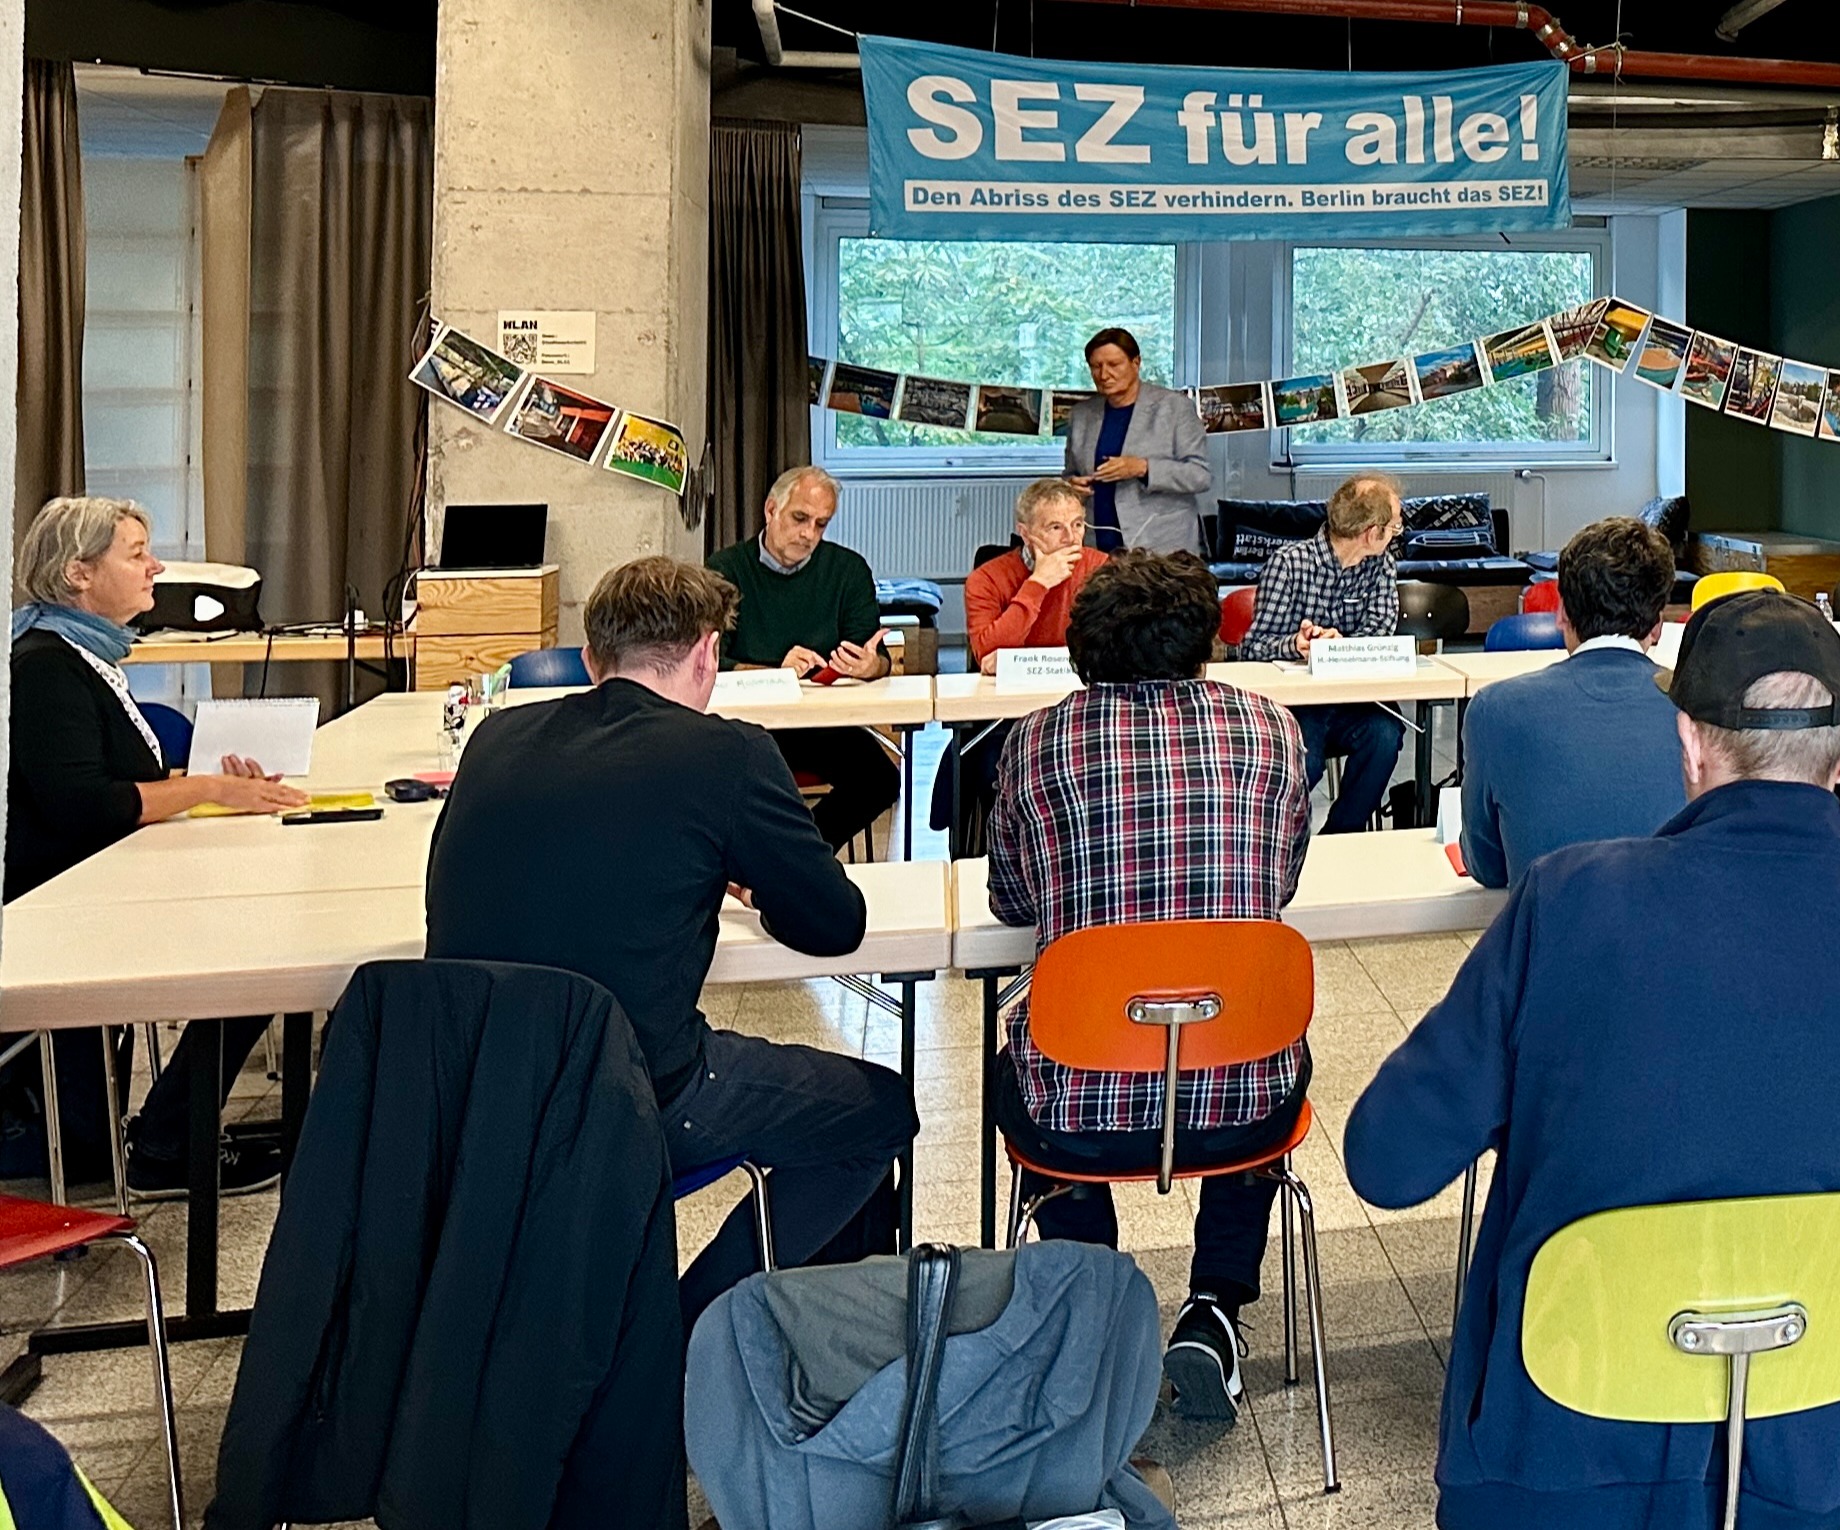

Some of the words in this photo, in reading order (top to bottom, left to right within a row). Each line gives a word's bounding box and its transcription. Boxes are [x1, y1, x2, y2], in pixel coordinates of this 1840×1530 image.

[906, 75, 1151, 163] SEZ
[1178, 91, 1322, 165] für
[1344, 95, 1538, 164] alle!
[912, 186, 961, 205] Den
[970, 188, 1049, 207] Abriss
[1057, 189, 1101, 207] des
[1109, 190, 1157, 208] SEZ
[1164, 189, 1293, 208] verhindern.
[1301, 190, 1365, 207] Berlin
[1372, 188, 1451, 205] braucht
[1457, 186, 1492, 202] das
[1498, 185, 1544, 201] SEZ!
[503, 320, 538, 330] WLAN
